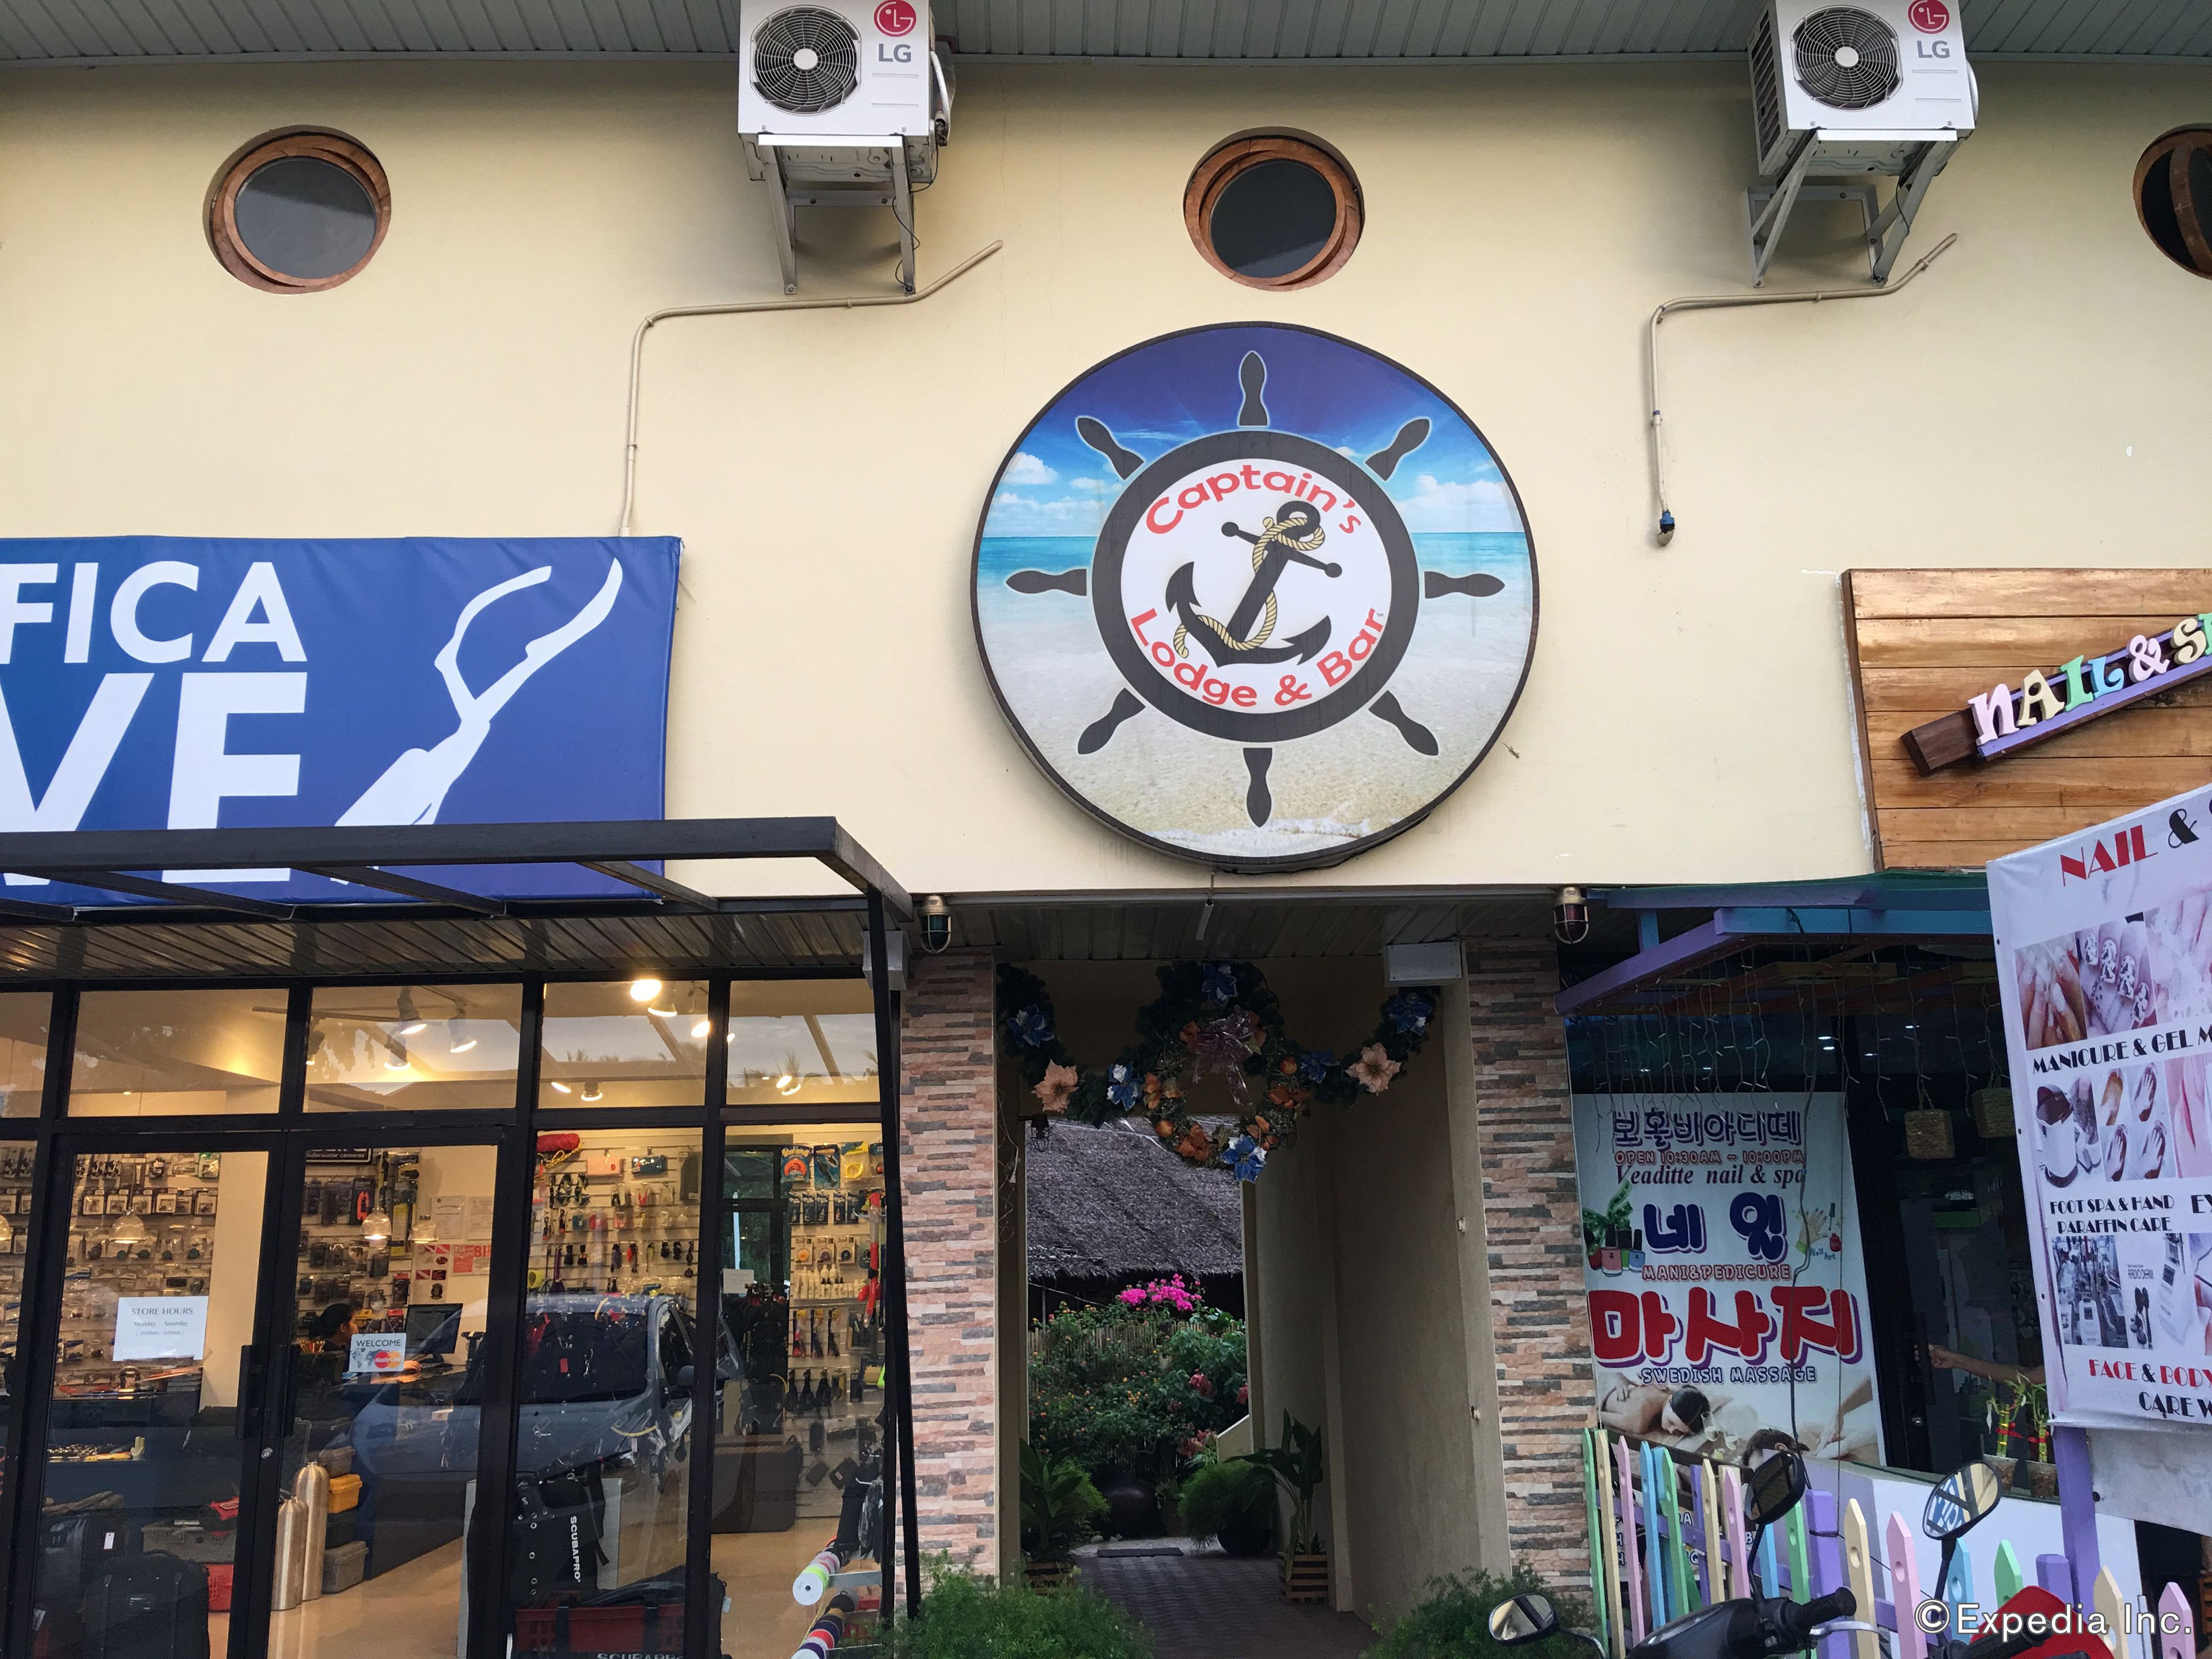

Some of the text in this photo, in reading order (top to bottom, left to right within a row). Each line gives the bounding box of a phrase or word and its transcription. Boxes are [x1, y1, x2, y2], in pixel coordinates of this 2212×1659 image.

[878, 43, 912, 63] LG
[1917, 40, 1950, 59] LG
[1146, 464, 1361, 535] Captain's
[0, 560, 308, 664] FICA
[1131, 608, 1383, 707] Lodge & Bar
[2128, 635, 2170, 683] &
[2060, 808, 2199, 887] NAIL &
[2033, 1041, 2130, 1074] MANICURE
[2133, 1037, 2148, 1057] &
[2152, 1029, 2194, 1052] GEL
[1614, 1151, 1657, 1165] OPEN
[1660, 1150, 1722, 1165] 10:30AM
[1743, 1149, 1805, 1165] 10:00PM
[1616, 1164, 1694, 1184] Veaditte
[1706, 1164, 1744, 1184] nail
[1749, 1164, 1767, 1184] &
[2050, 1194, 2175, 1214] FOOT SPA & HAND
[2057, 1217, 2172, 1234] PARAFFIN CARE
[1642, 1263, 1791, 1281] MANI&PEDICURE
[1588, 1286, 1863, 1369] 마사지
[356, 1339, 402, 1347] WELCOME
[1641, 1366, 1817, 1384] SWEDISH MASSAGE
[2089, 1359, 2138, 1381] FACE
[2142, 1363, 2156, 1383] &
[2138, 1391, 2195, 1418] CARE
